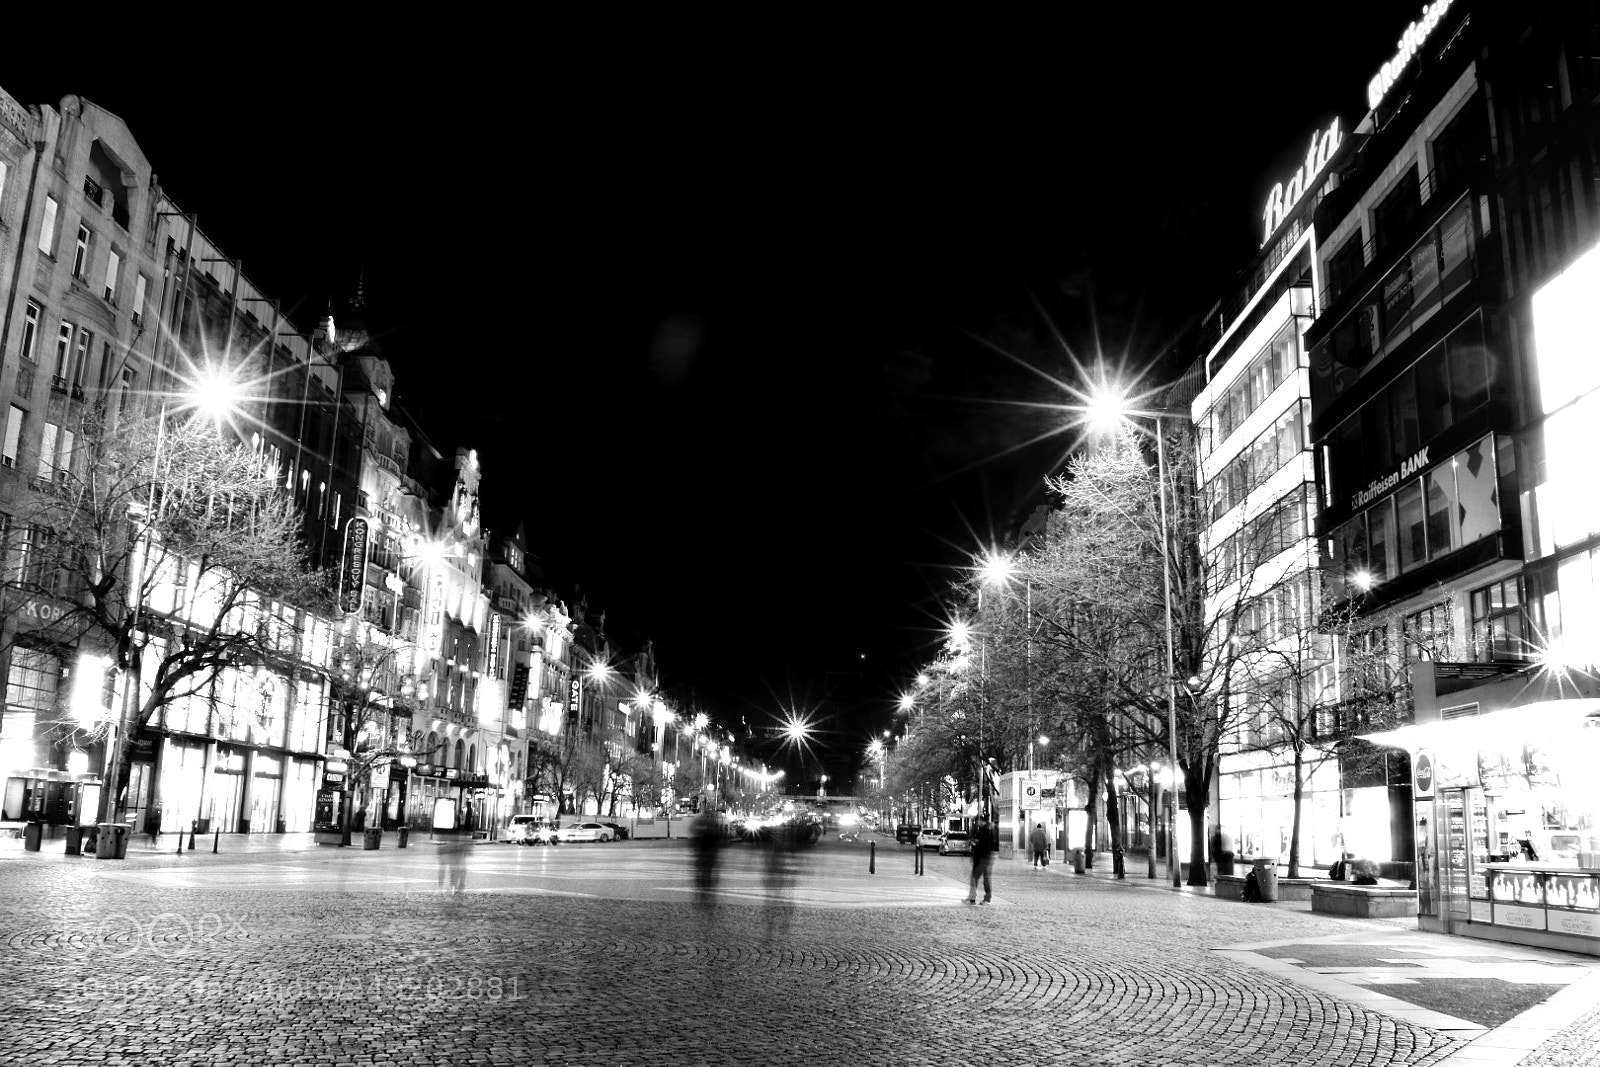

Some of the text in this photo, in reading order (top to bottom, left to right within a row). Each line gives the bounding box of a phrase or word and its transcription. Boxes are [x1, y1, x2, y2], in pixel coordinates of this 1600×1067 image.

[1380, 0, 1453, 93] Raiffeise
[1358, 445, 1430, 506] Raiffeisen BANK
[571, 680, 580, 711] GATE
